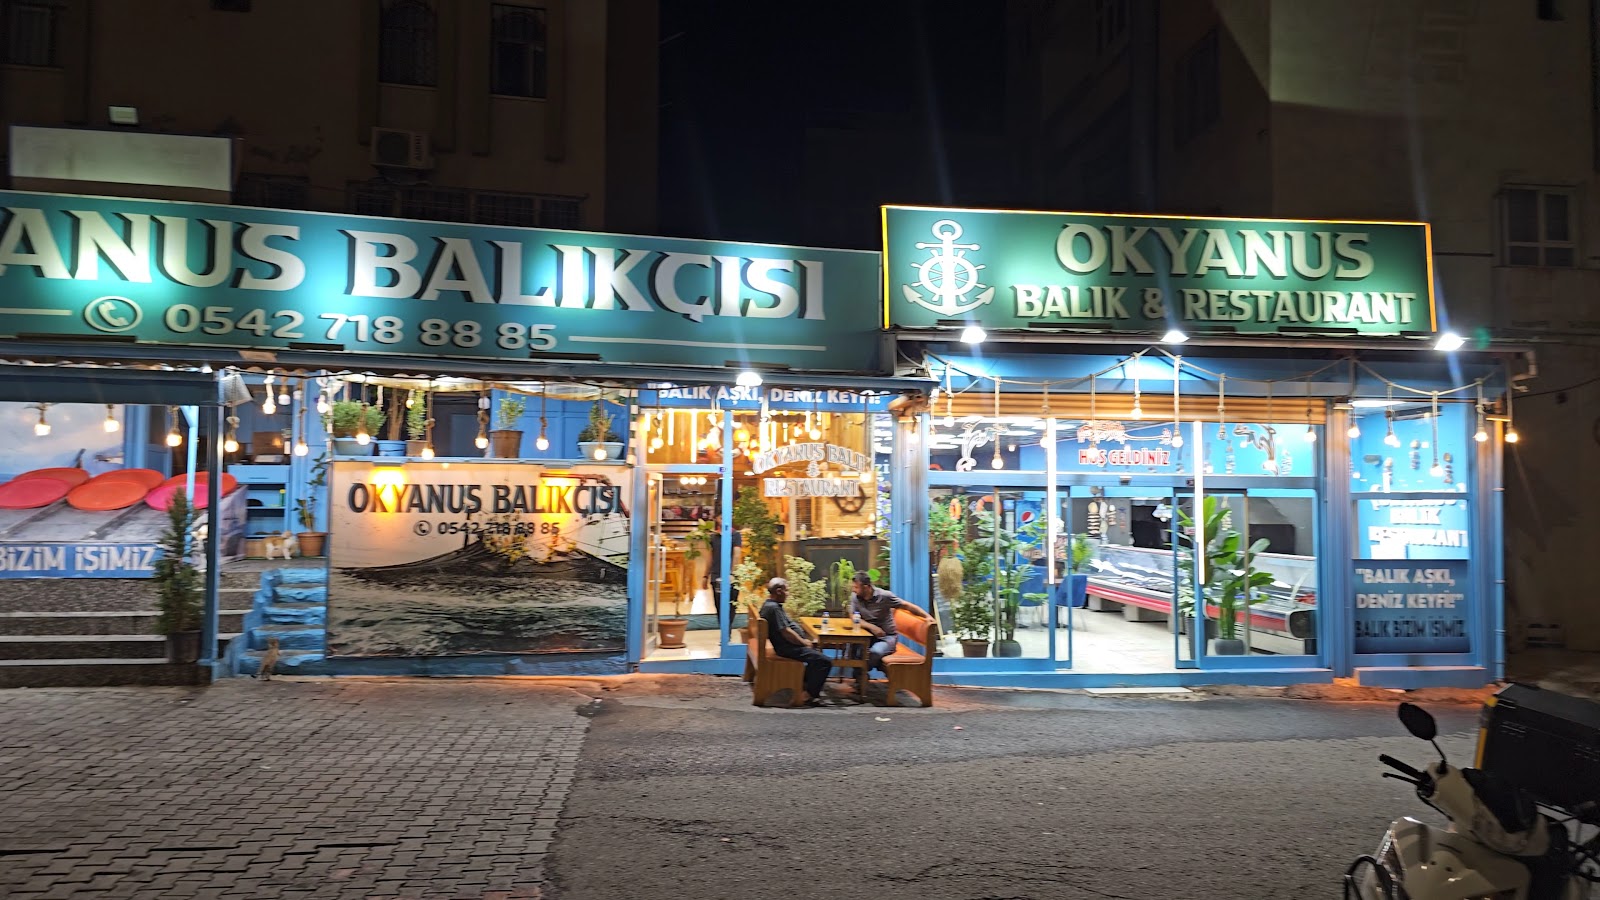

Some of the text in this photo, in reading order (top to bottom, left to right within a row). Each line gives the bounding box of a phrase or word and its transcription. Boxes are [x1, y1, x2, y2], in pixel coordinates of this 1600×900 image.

[0, 206, 826, 323] ANUS BALIKÇISI
[1054, 223, 1376, 280] OKYANUS
[1014, 284, 1417, 324] BALIK & RESTAURANT
[164, 303, 558, 351] 0542 718 88 85
[752, 442, 826, 475] OKYANUS
[1109, 447, 1171, 466] GELDİNİZ
[348, 482, 482, 515] OKYANUS
[437, 521, 480, 535] 0542
